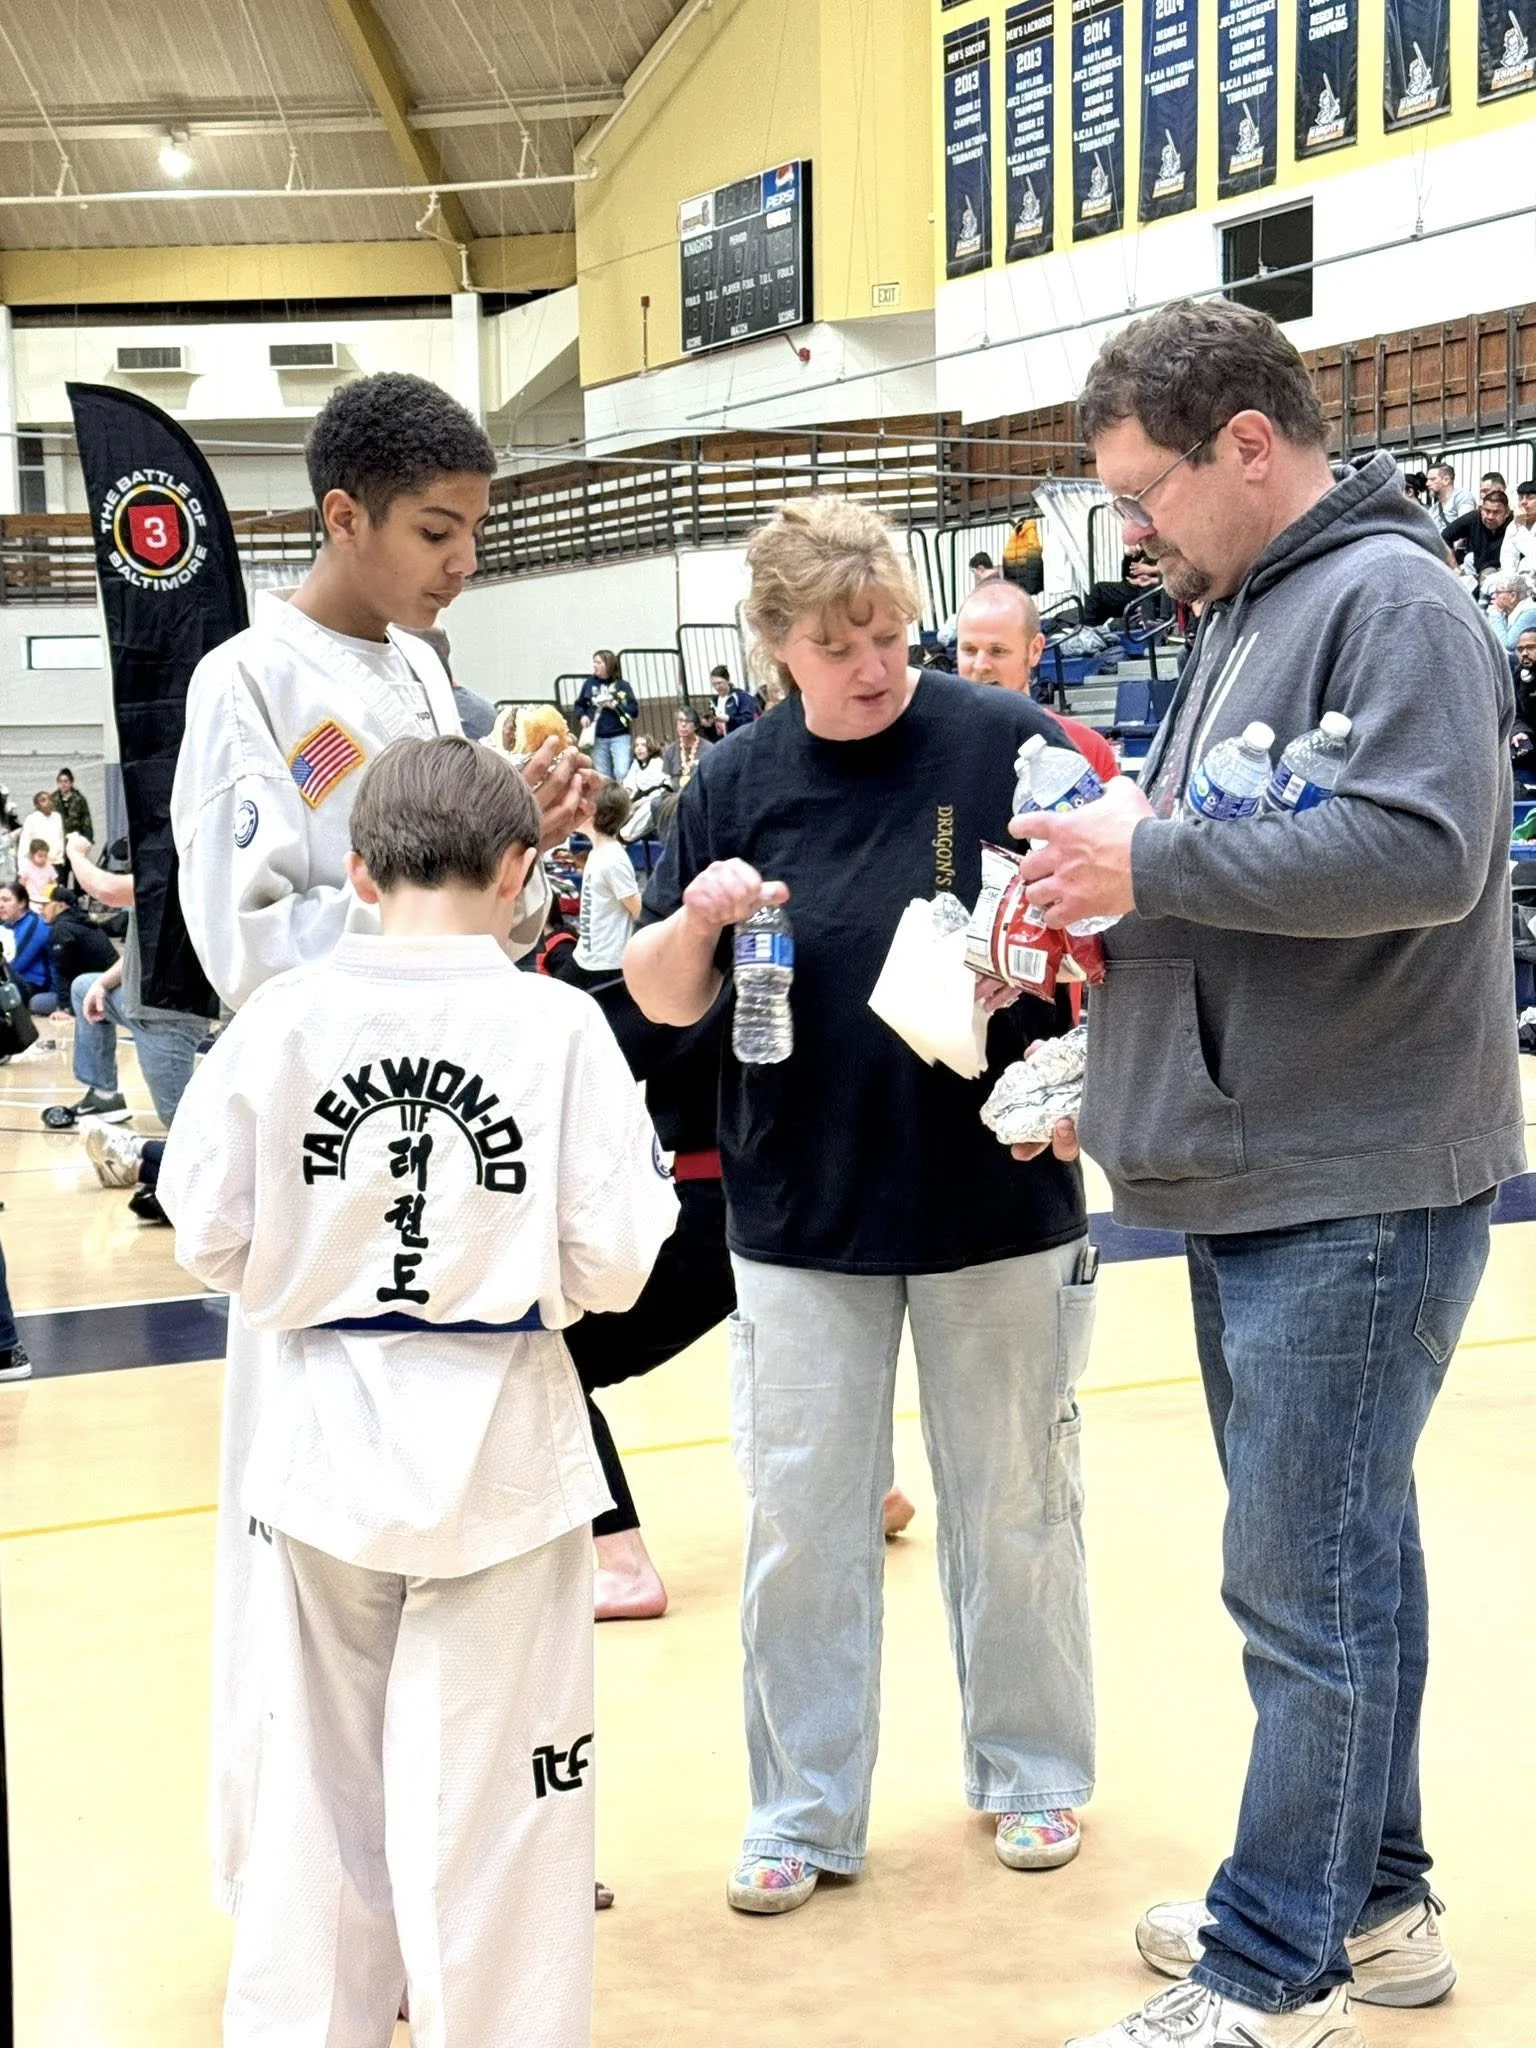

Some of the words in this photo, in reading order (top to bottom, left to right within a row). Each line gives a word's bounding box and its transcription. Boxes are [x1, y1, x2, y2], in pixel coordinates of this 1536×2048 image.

[1236, 0, 1276, 23] CONFERENCE
[1310, 7, 1334, 27] REGION
[1334, 3, 1347, 19] XX
[1083, 17, 1111, 47] 2014
[1155, 25, 1178, 42] REGION
[1229, 16, 1266, 40] CHAMPIONS
[1308, 17, 1349, 42] CHAMPIONS
[1153, 35, 1188, 57] CHAMPIONS
[1232, 38, 1255, 56] REGION
[1016, 46, 1042, 74] 2013
[1088, 55, 1122, 77] CONFERENCE
[1166, 59, 1195, 77] NATIONAL
[1229, 49, 1266, 72] CHAMPIONS
[954, 70, 979, 97] 2013
[1081, 72, 1114, 93] CHAMPIONS
[1150, 74, 1190, 97] TOURNAMENT
[1242, 64, 1274, 85] NATIONAL
[1021, 83, 1052, 104] CONFERENCE
[1226, 81, 1268, 106] TOURNAMENT
[1014, 99, 1044, 119] CHAMPIONS
[1081, 102, 1114, 122] CHAMPIONS
[1094, 118, 1121, 136] NATIONAL
[1014, 129, 1044, 148] CHAMPIONS
[1079, 132, 1116, 154] TOURNAMENT
[952, 145, 982, 166] TOURNAMENT
[1025, 144, 1051, 160] NATIONAL
[1011, 158, 1047, 178] TOURNAMENT
[765, 188, 795, 209] PEPSI
[684, 235, 712, 257] KNIGHTS
[776, 265, 793, 279] FOULS
[878, 287, 896, 303] EXIT
[100, 488, 120, 534] THE
[115, 468, 191, 498] BATTLE
[187, 497, 207, 528] OF
[143, 516, 167, 549] 3
[108, 544, 208, 591] BALTIMORE
[931, 804, 956, 887] DRAGON'S
[581, 873, 593, 952] SUMMIT
[303, 1057, 527, 1194] TAEKWON-DO
[400, 1102, 432, 1133] ITF
